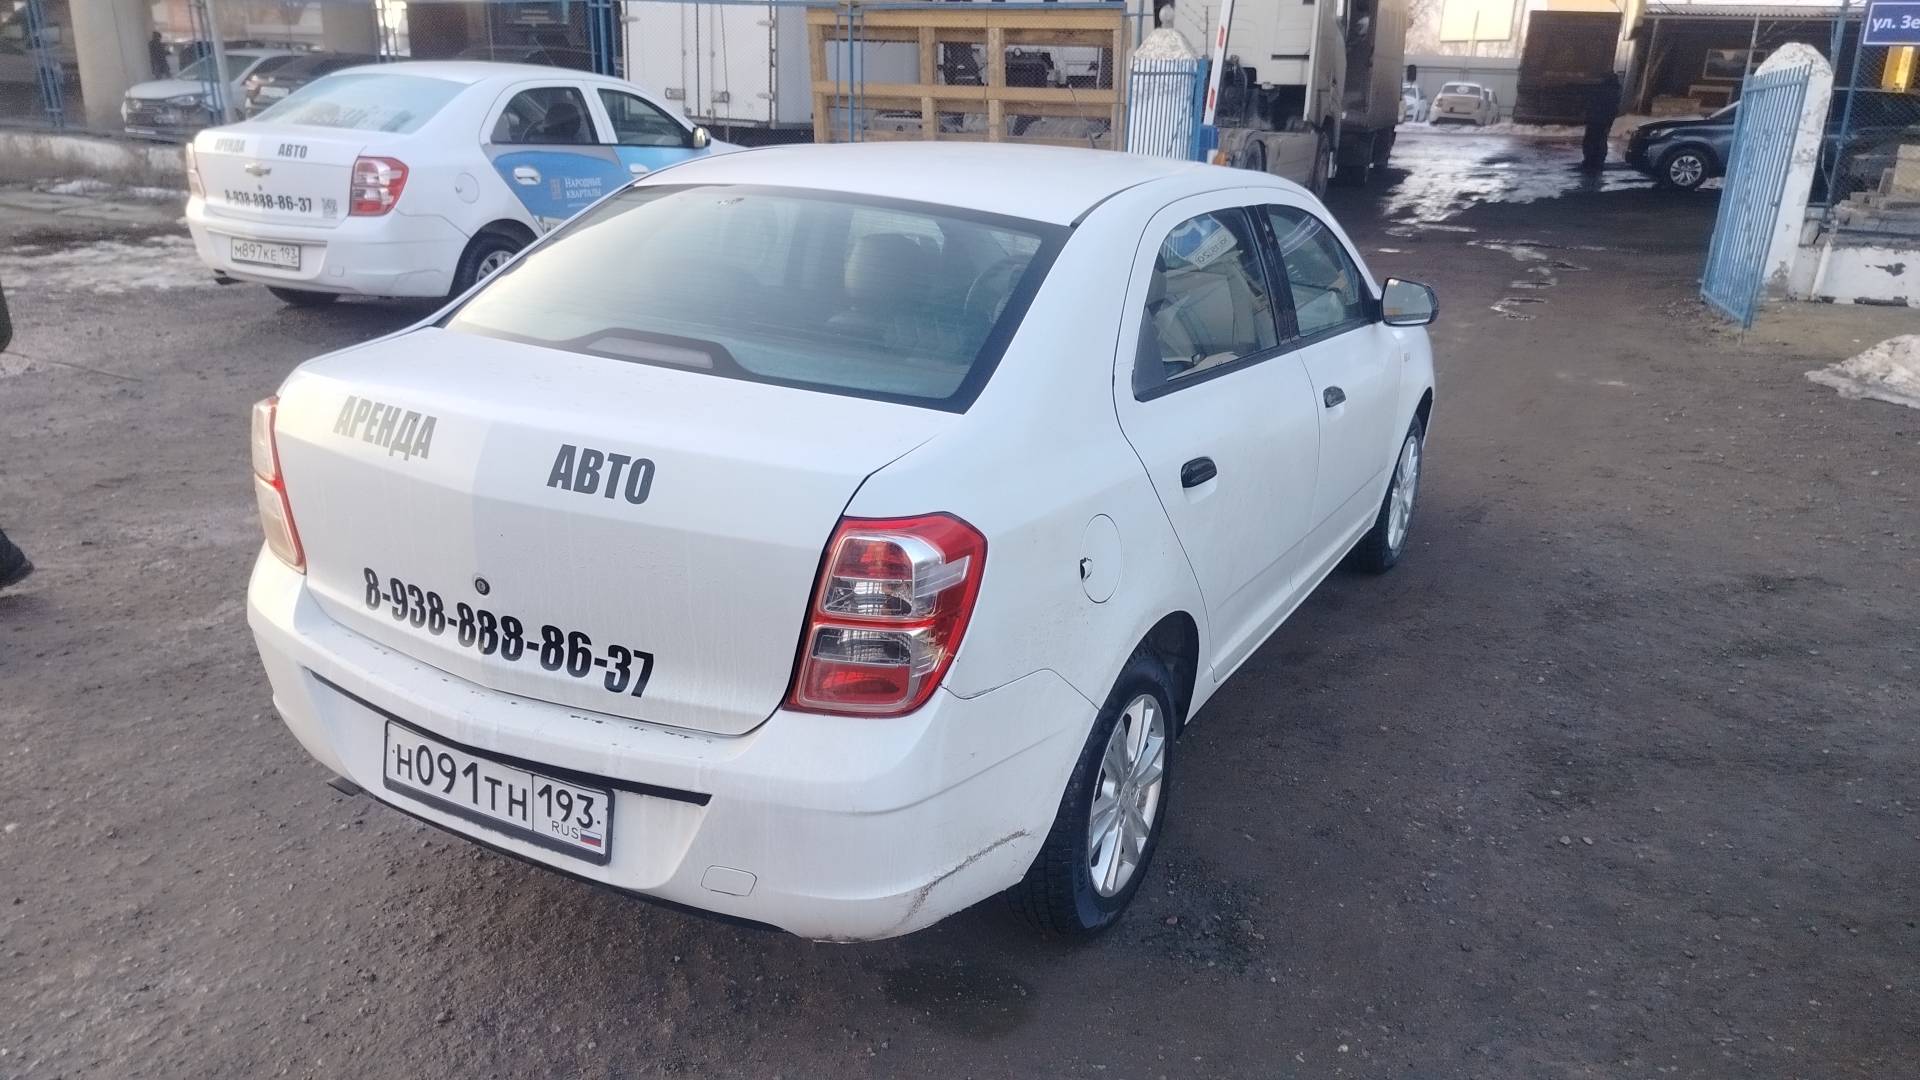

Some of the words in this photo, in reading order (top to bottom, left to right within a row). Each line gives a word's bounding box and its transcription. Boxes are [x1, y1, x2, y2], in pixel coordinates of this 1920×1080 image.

[1872, 17, 1896, 32] ул.
[278, 143, 308, 159] АВТО
[225, 189, 312, 213] 8-938-888-86-37
[280, 246, 298, 260] 193
[332, 395, 438, 461] АРЕНДА
[547, 444, 656, 505] АВТО
[364, 567, 654, 698] 8-938-888-86-37
[396, 743, 528, 822] Н091ТН
[537, 783, 595, 829] 193
[551, 820, 580, 840] RUS
